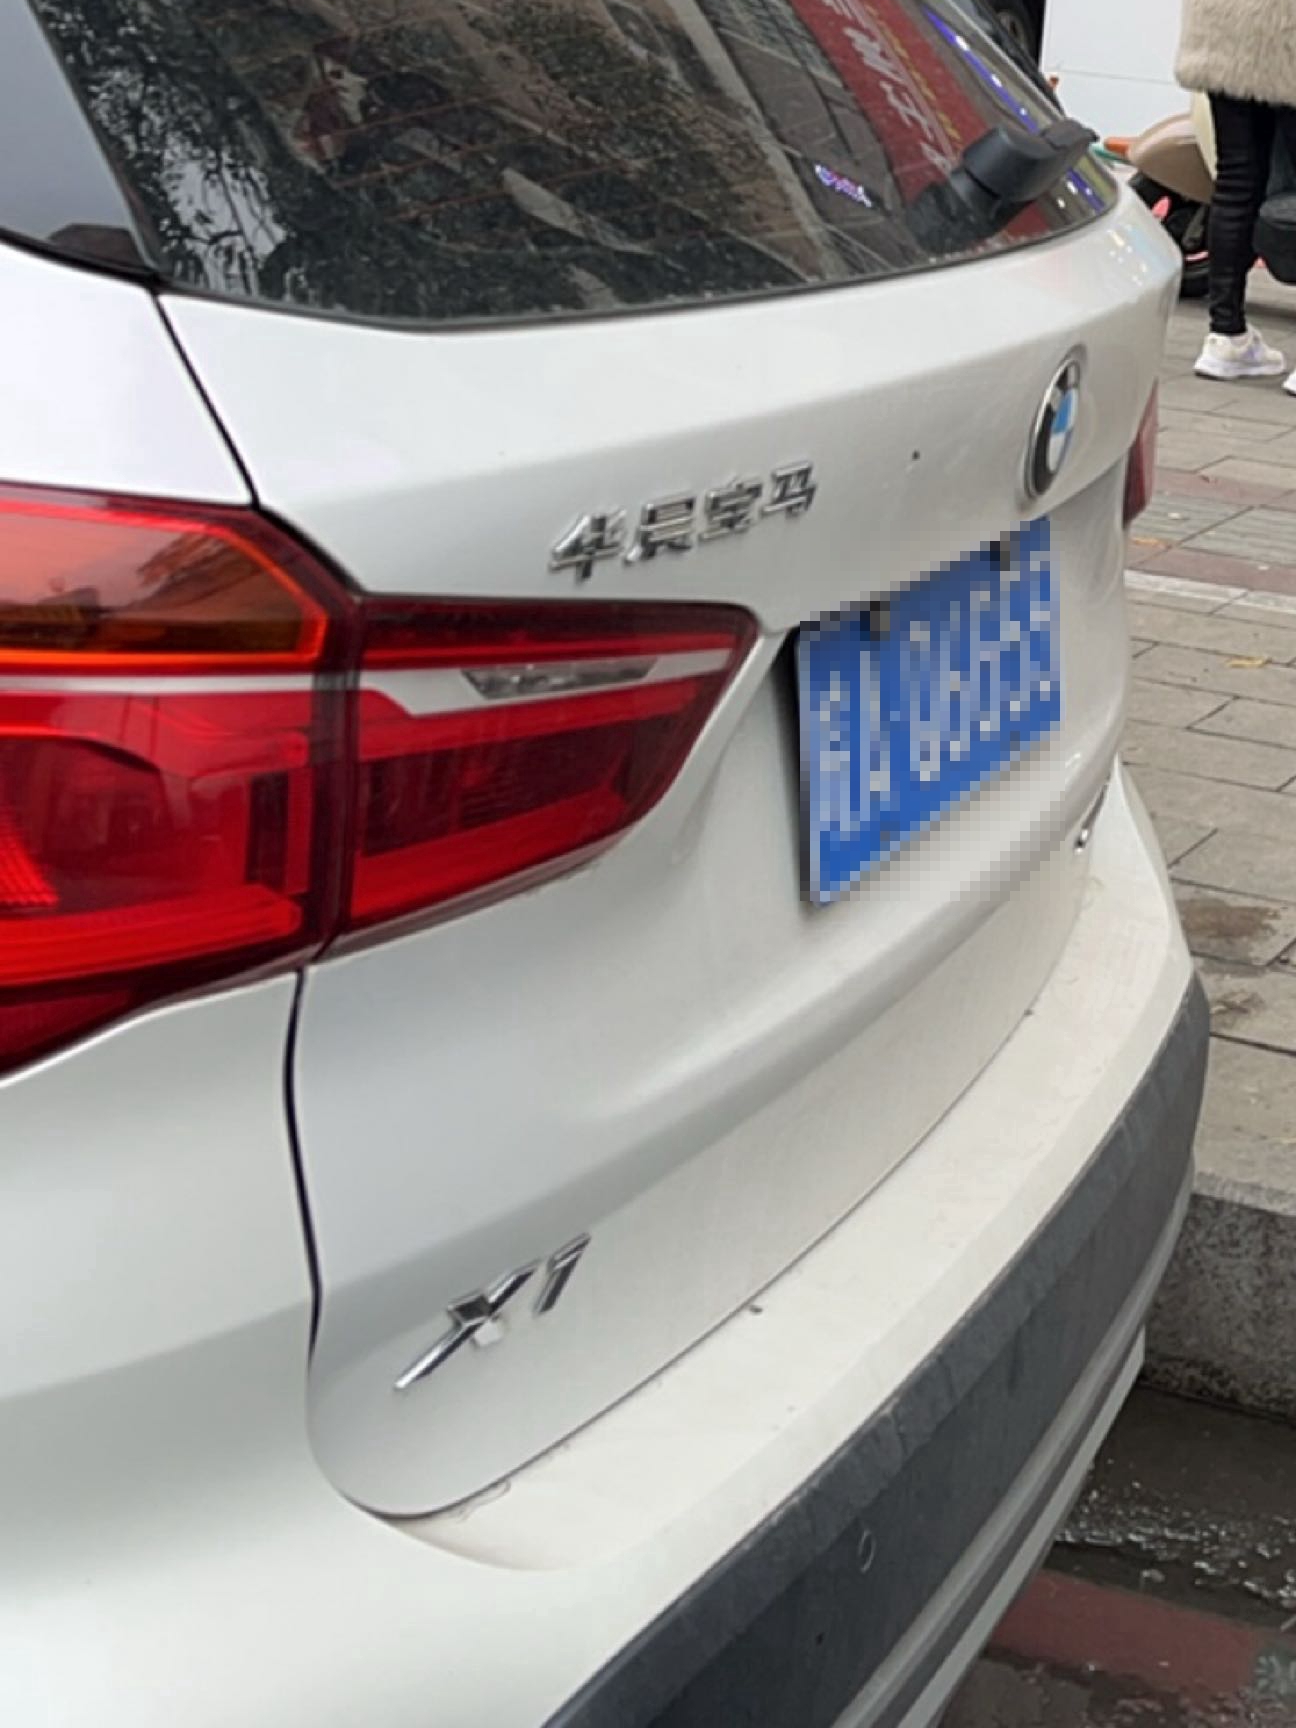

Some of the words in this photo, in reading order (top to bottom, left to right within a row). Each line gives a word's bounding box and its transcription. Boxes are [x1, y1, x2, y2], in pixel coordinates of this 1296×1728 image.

[549, 459, 817, 586] 华晨宝马
[393, 1232, 592, 1390] X1
